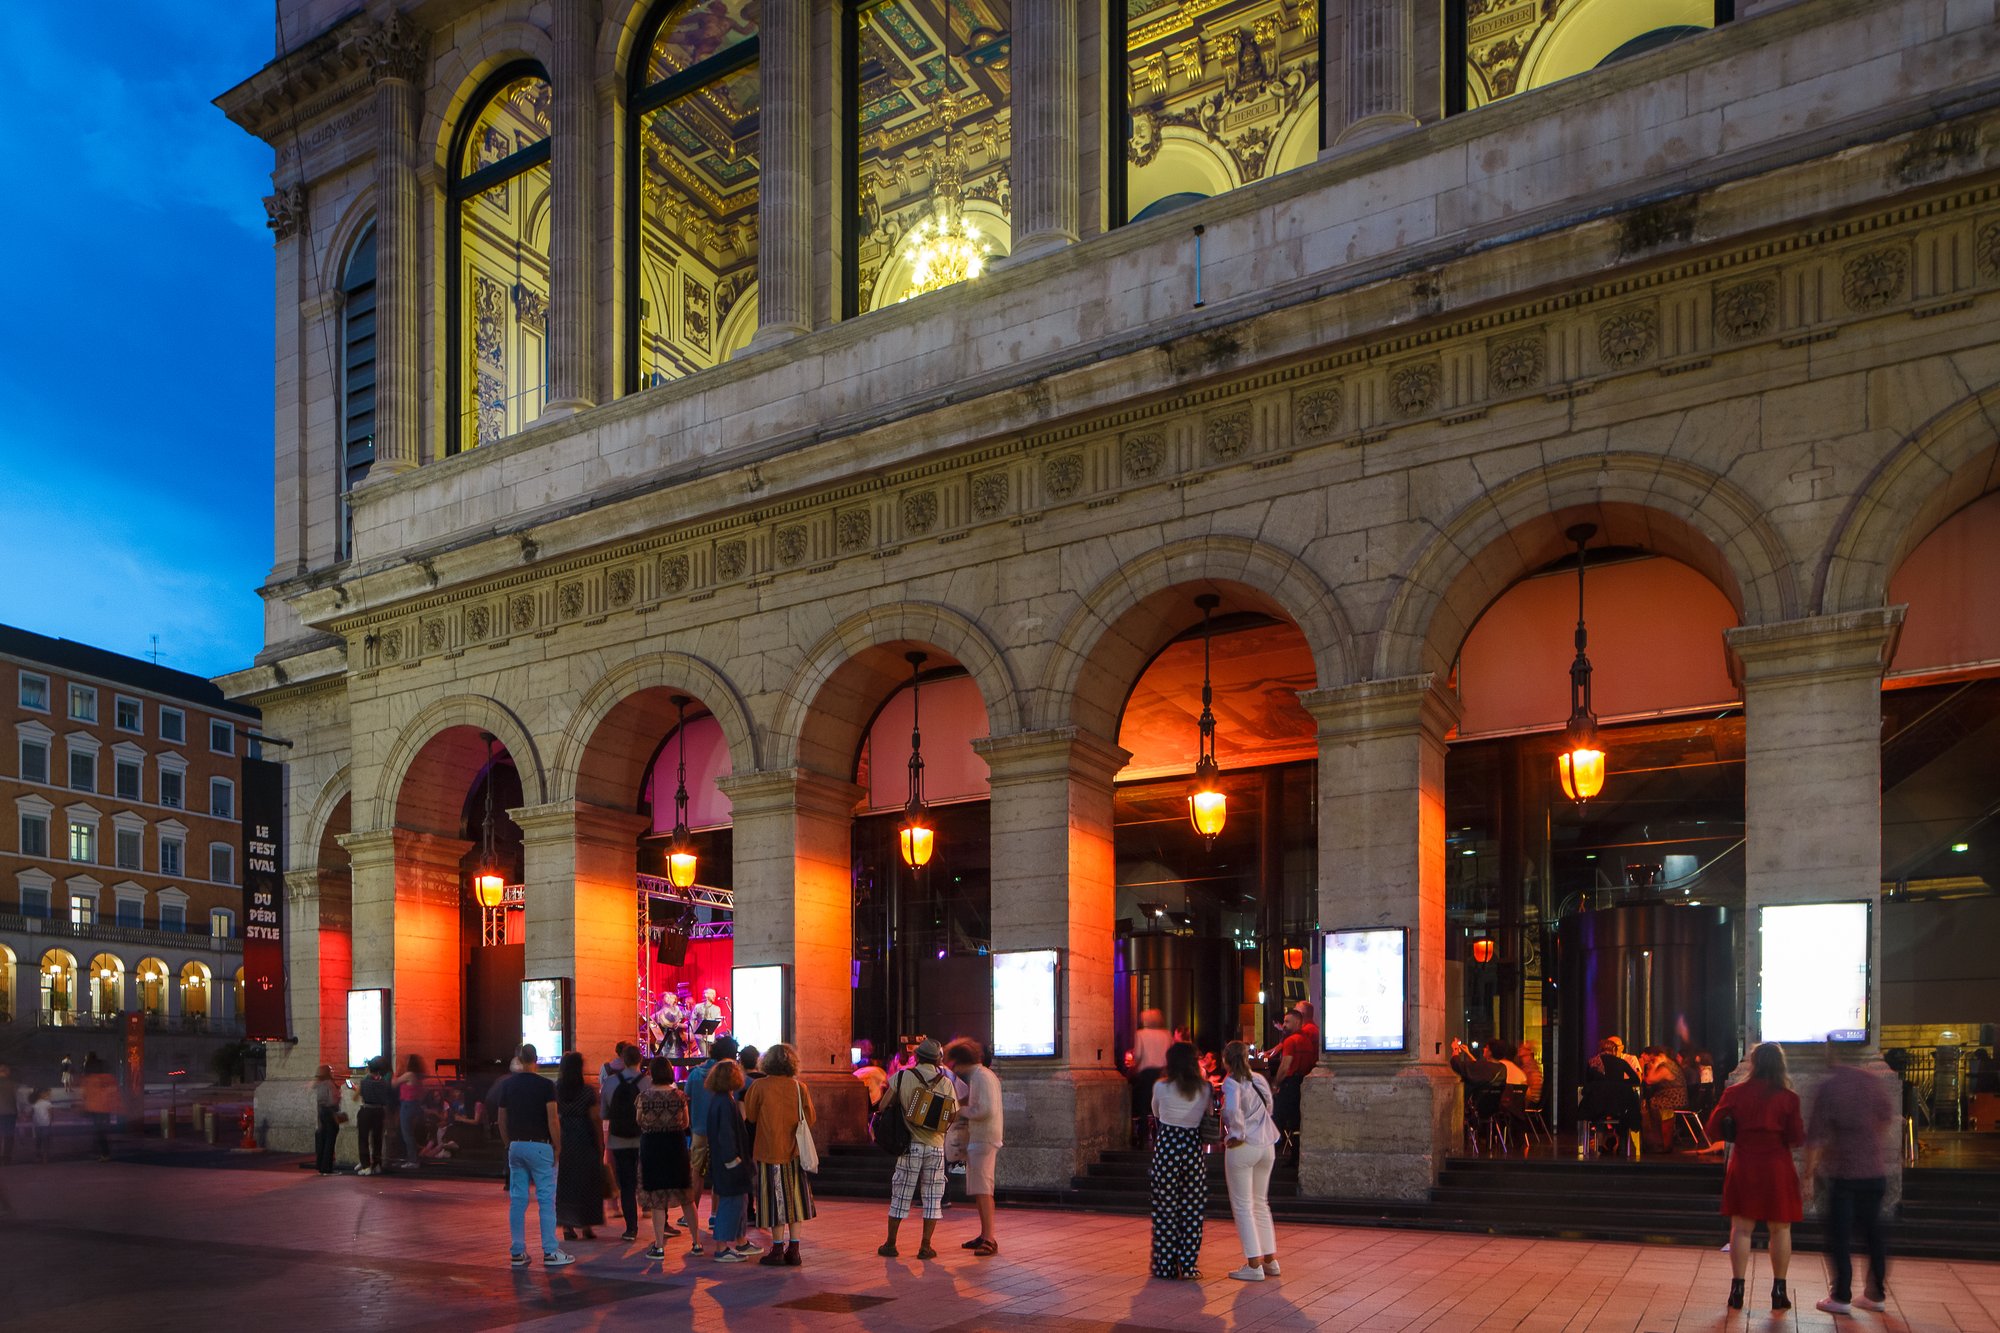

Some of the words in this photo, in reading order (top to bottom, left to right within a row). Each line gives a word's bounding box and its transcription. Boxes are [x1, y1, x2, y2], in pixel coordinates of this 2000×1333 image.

[256, 825, 269, 838] LE
[249, 841, 276, 856] FEST
[249, 858, 276, 873] IVAL
[254, 892, 271, 906] DU
[249, 907, 276, 923] PÉRI
[247, 925, 280, 940] STYLE
